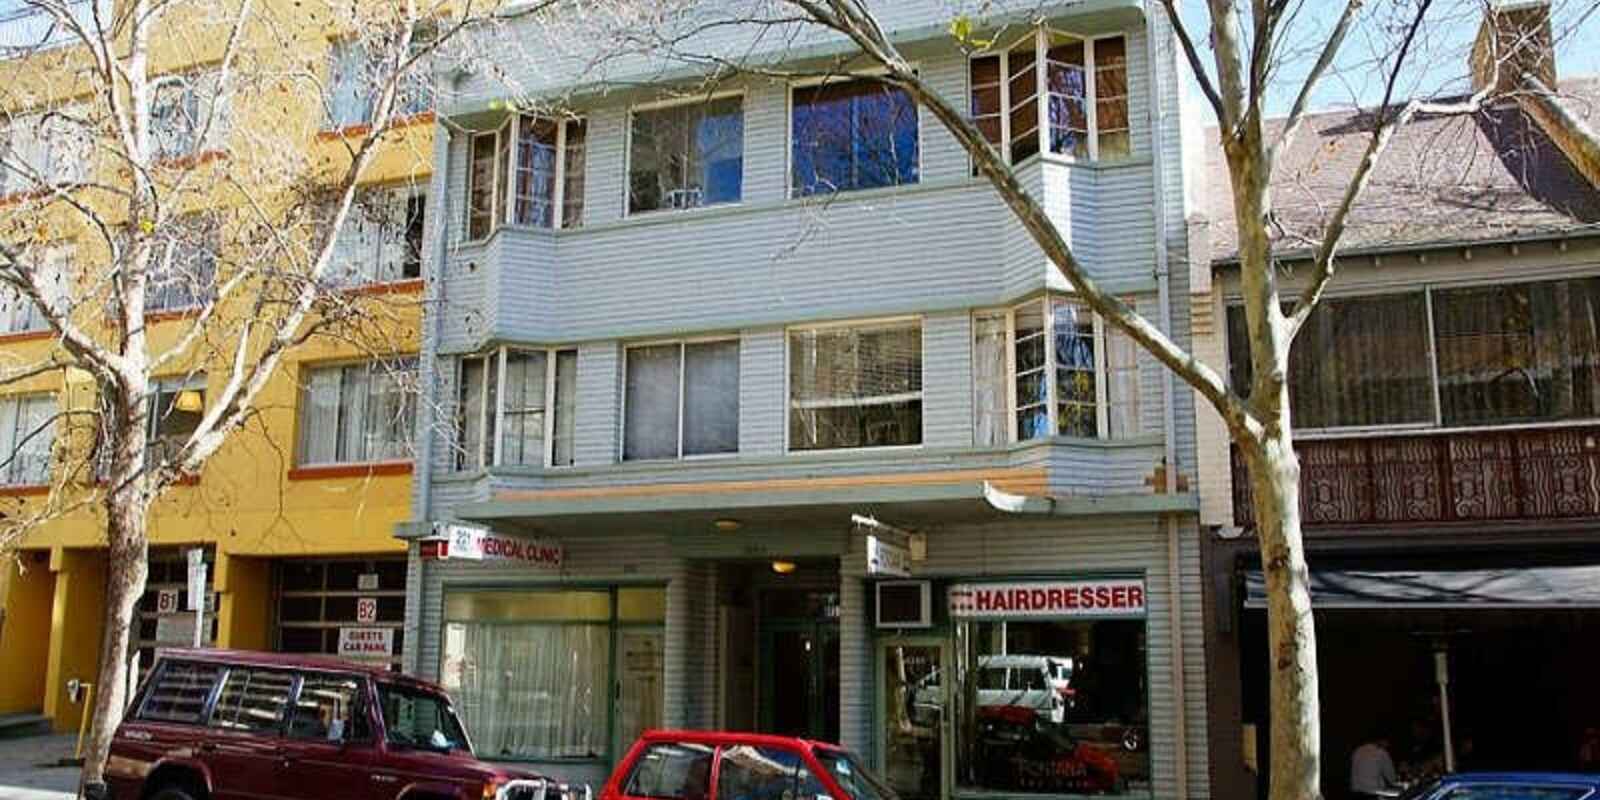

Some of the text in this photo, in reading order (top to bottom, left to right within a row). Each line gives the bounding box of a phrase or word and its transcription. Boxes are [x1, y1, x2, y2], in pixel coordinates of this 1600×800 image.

[476, 535, 560, 565] MEDICAL CLINIC
[159, 593, 177, 611] B1
[976, 586, 1144, 611] HAIRDRESSER
[359, 601, 375, 619] B2
[343, 642, 385, 652] CAR PARK
